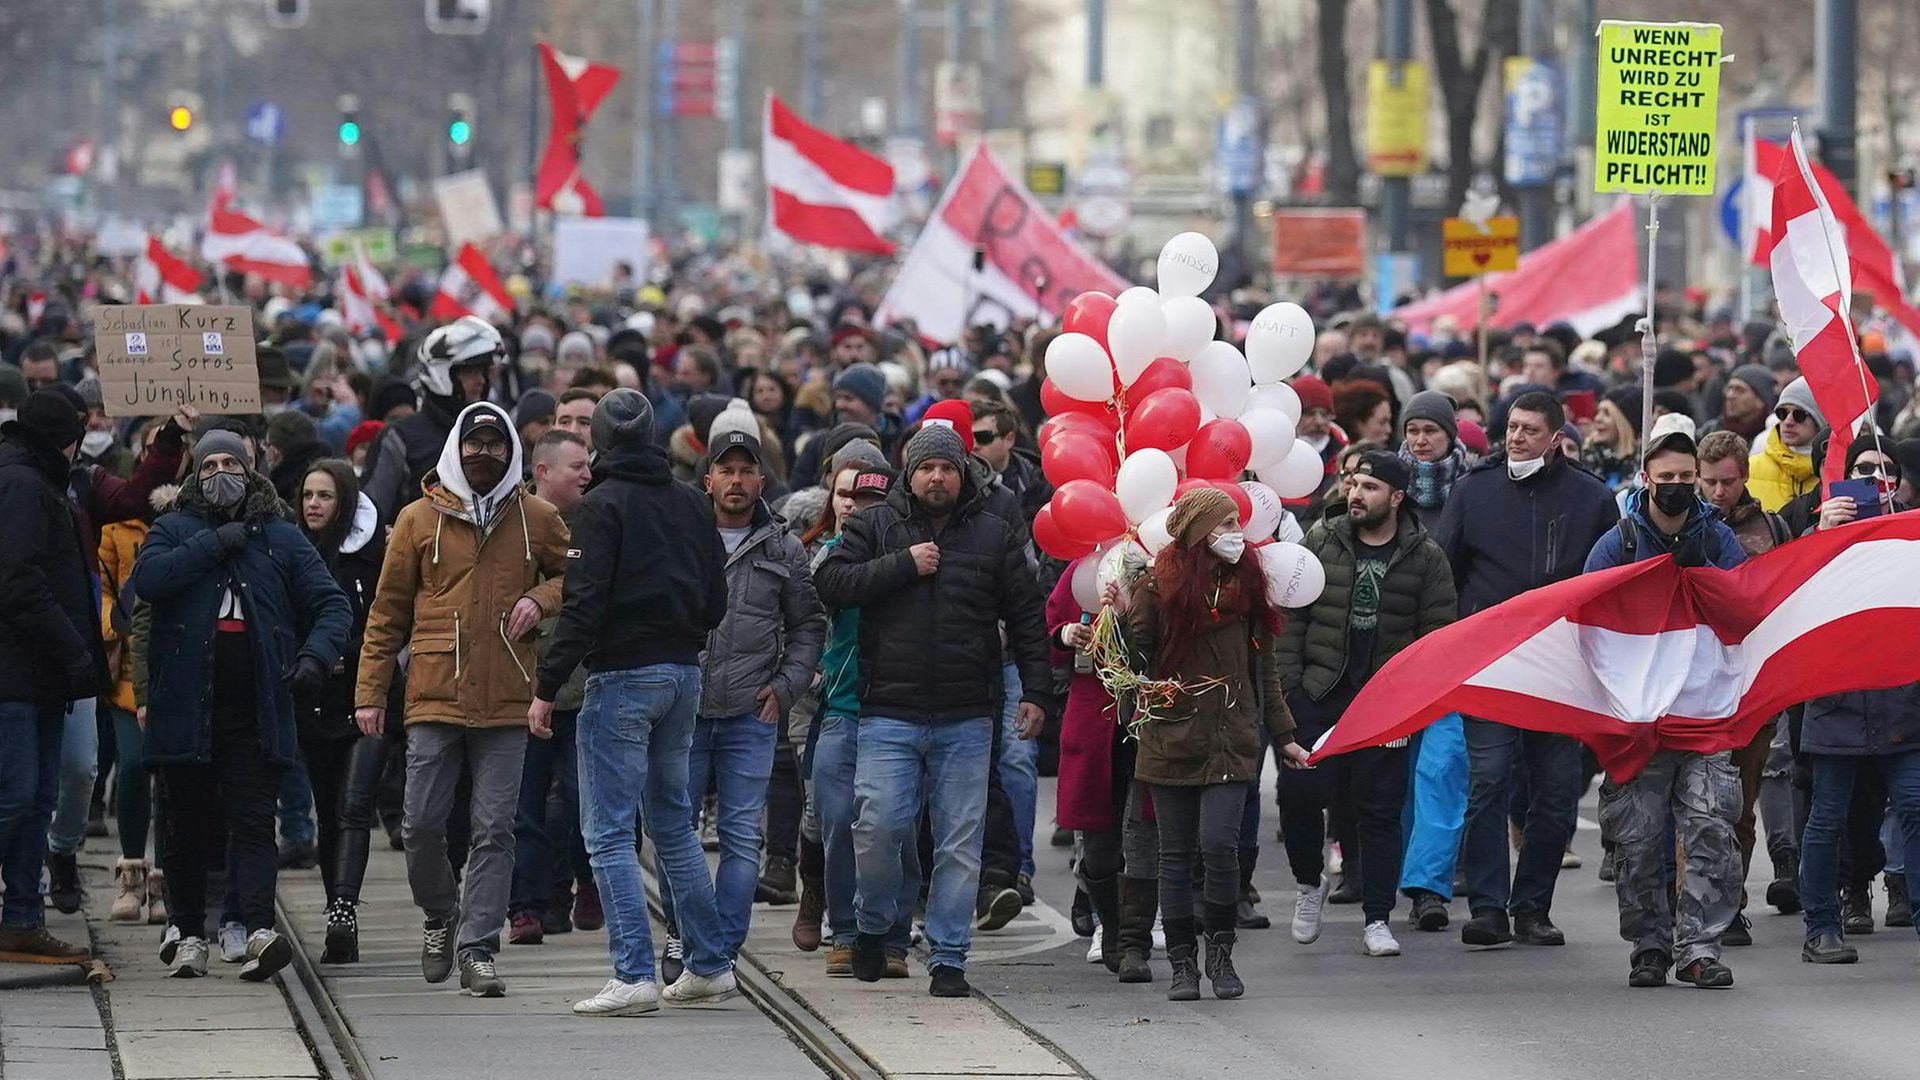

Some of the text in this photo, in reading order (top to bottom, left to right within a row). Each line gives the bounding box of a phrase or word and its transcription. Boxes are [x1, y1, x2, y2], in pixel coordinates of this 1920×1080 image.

[1634, 29, 1690, 46] WENN
[1611, 47, 1717, 67] UNRECHT
[1620, 69, 1700, 87] WIRD ZU
[1620, 90, 1706, 108] RECHT
[1645, 113, 1671, 126] IST
[1607, 130, 1710, 157] WIDERSTAND
[1606, 162, 1706, 185] PFLICHT!!
[103, 307, 236, 331] Sebastian Kurz
[106, 349, 233, 371] George Soros
